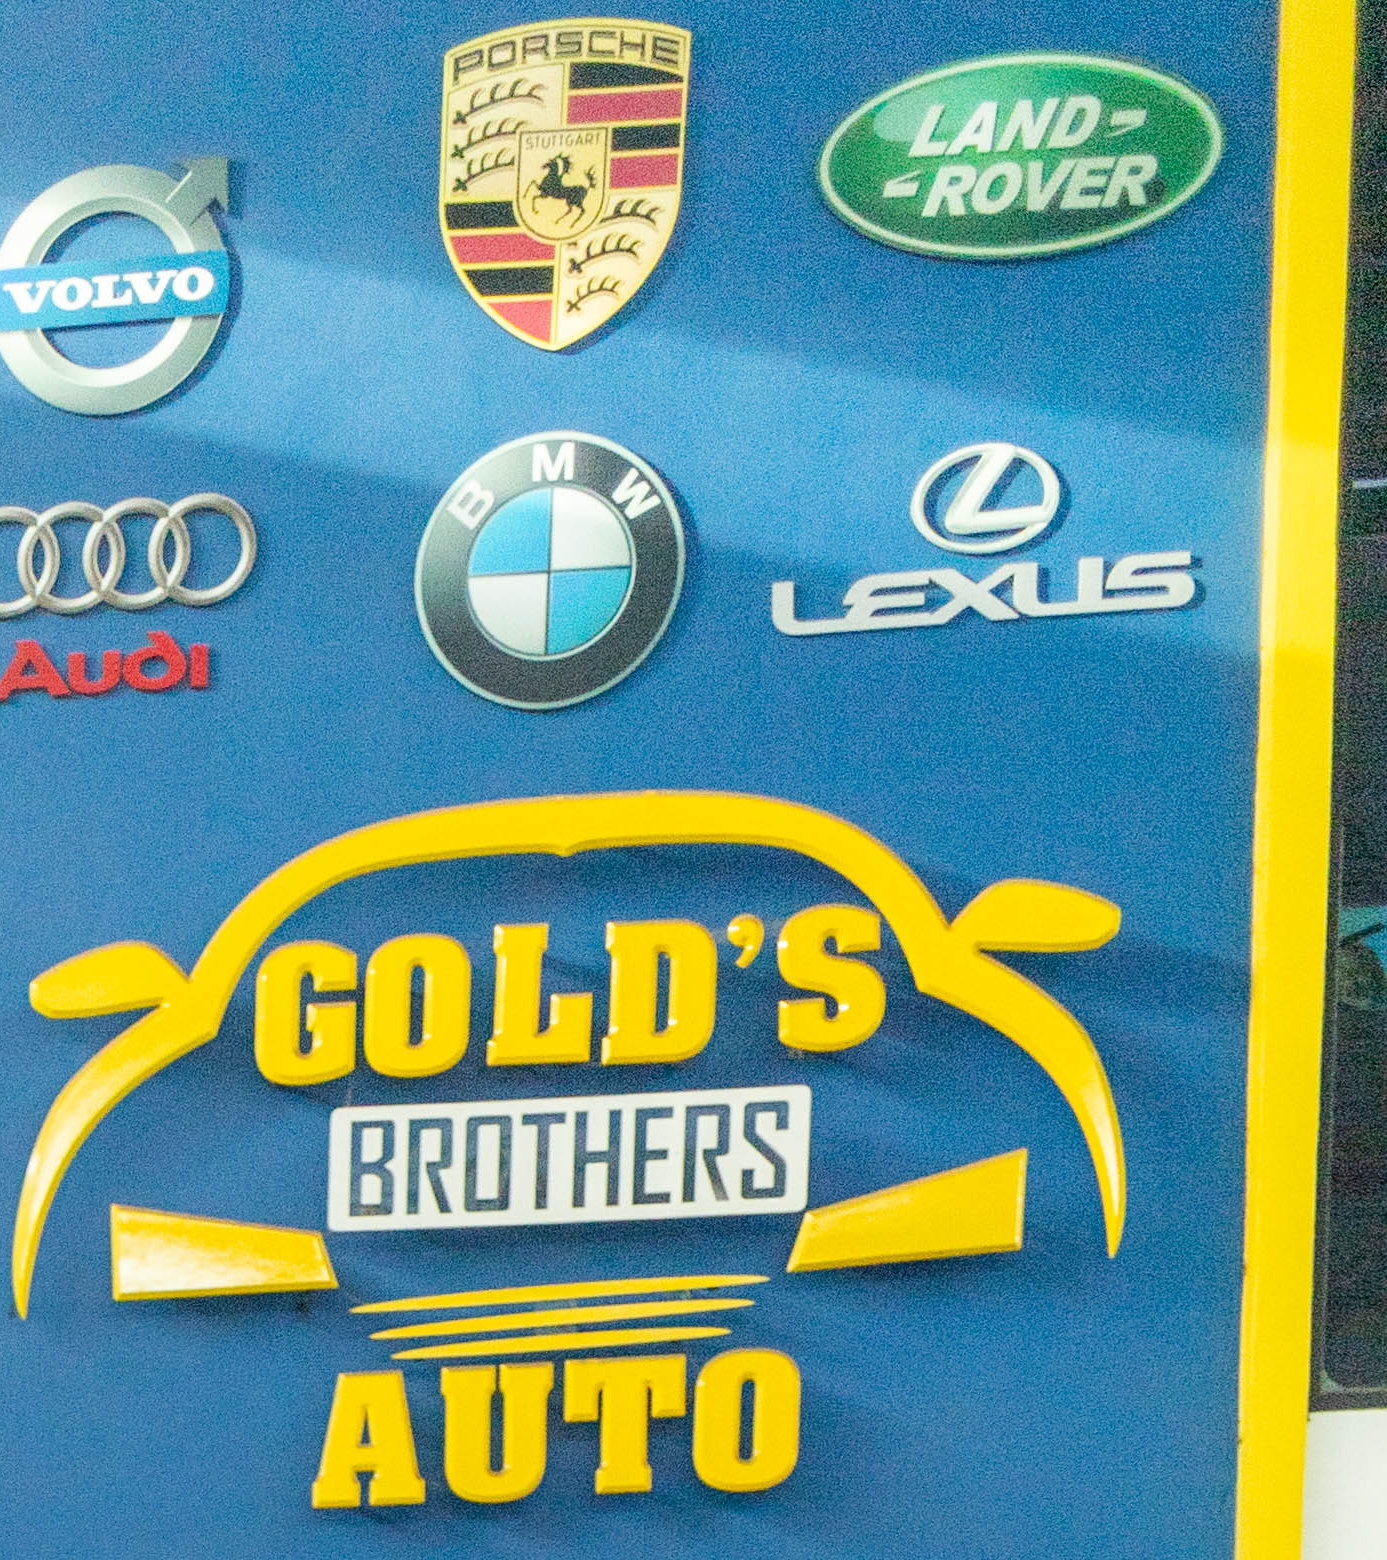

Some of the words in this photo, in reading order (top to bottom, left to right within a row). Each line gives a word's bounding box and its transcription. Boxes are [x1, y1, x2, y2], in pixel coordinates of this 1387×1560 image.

[453, 30, 679, 85] PORSCHE
[523, 132, 602, 151] STUTTGART
[2, 266, 215, 314] VOLVO
[770, 550, 1196, 637] LEXUS
[254, 903, 887, 1087] GOLD'S
[349, 1101, 790, 1217] BROTHERS
[311, 1347, 802, 1509] AUTO
